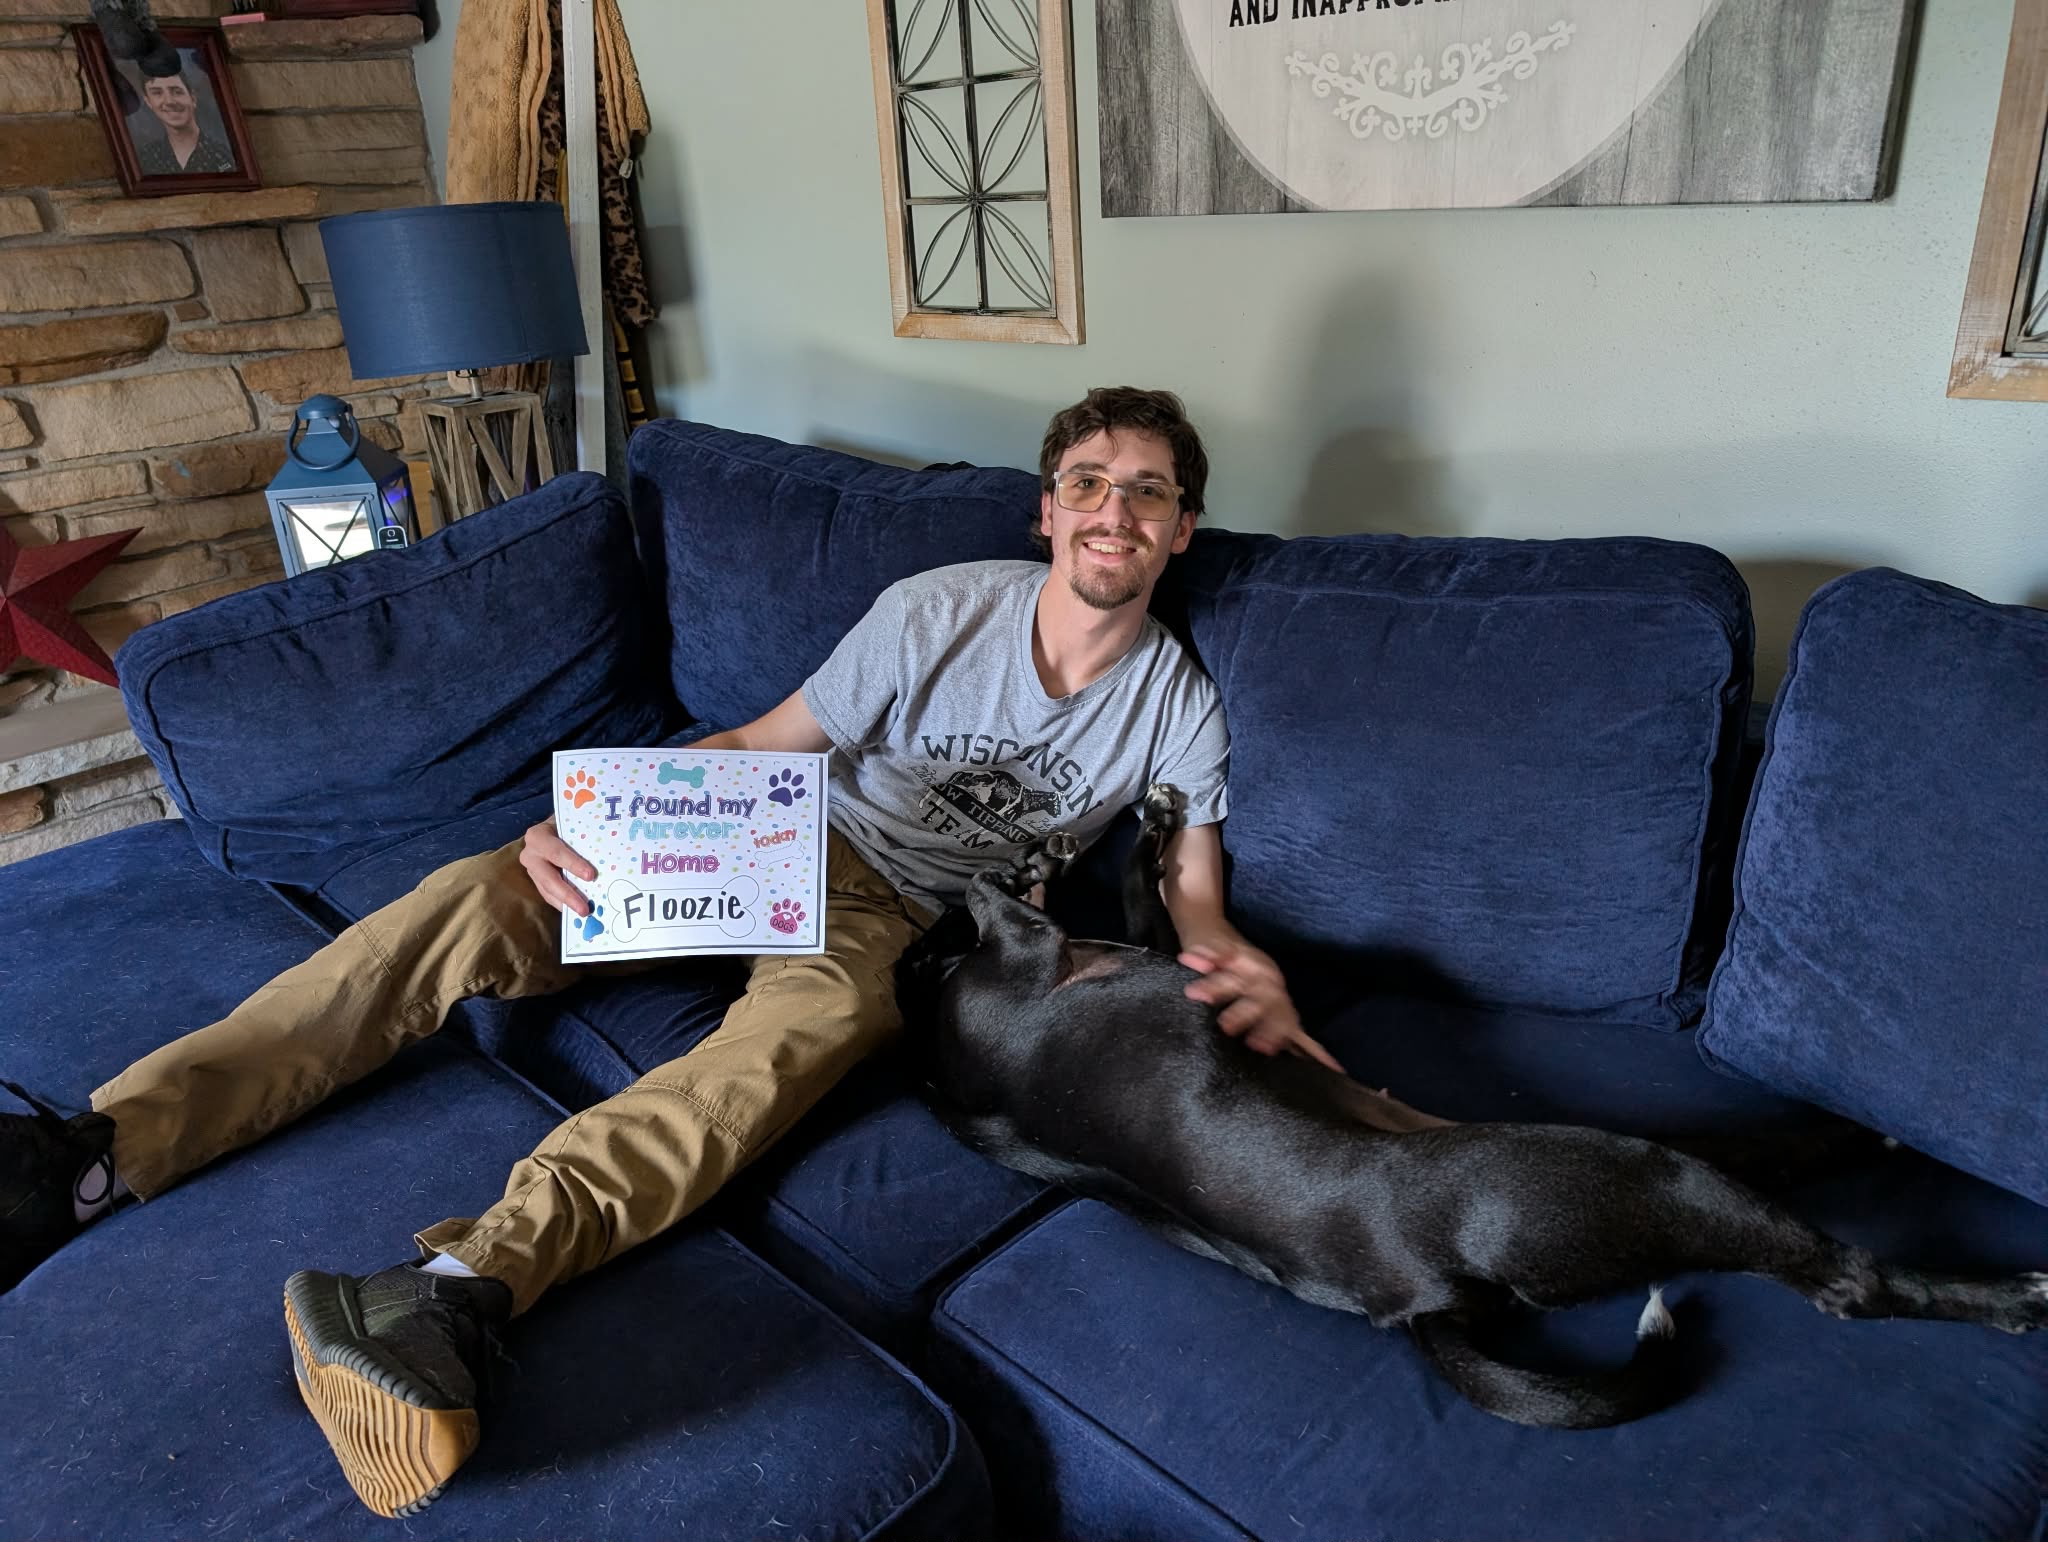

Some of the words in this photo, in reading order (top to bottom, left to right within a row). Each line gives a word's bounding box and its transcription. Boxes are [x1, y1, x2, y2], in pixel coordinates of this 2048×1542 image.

[1229, 0, 1279, 27] AND
[605, 795, 622, 821] I
[628, 793, 712, 818] found
[718, 797, 758, 820] my
[628, 818, 736, 841] furever
[753, 828, 797, 848] today
[641, 852, 721, 875] Home
[624, 891, 745, 928] Floozie
[772, 918, 795, 933] DOGS
